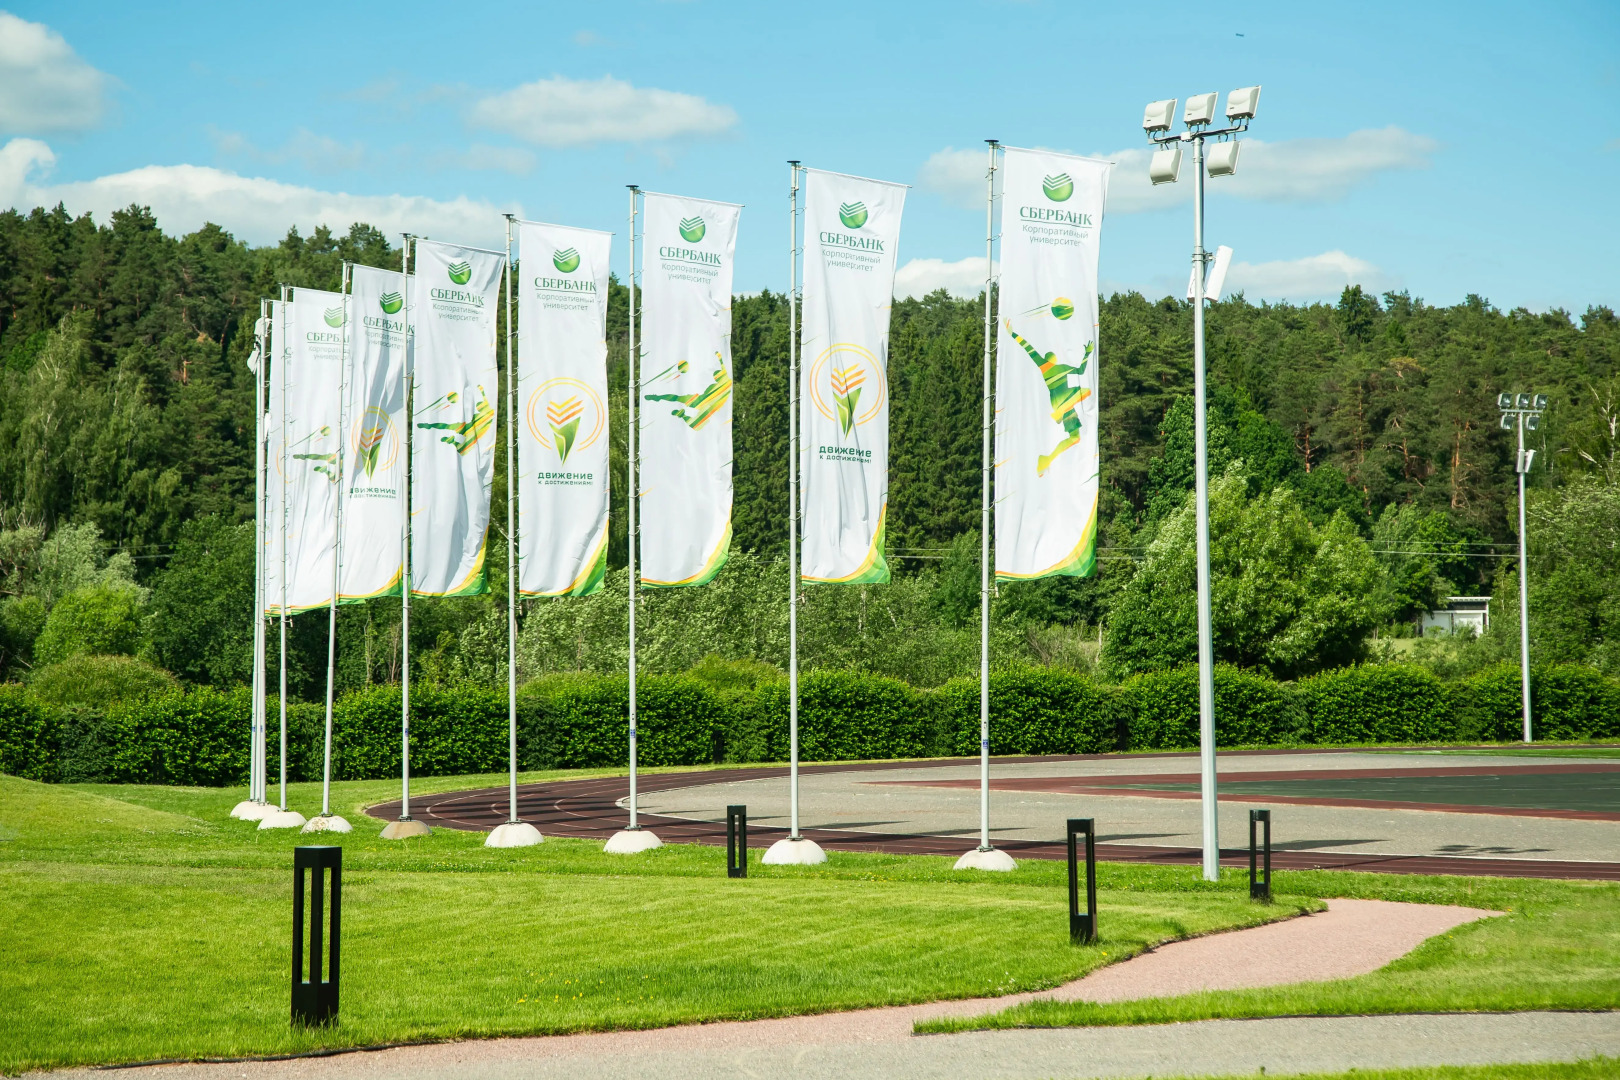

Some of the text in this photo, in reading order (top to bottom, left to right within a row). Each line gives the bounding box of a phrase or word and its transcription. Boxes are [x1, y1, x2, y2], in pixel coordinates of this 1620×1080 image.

[1019, 206, 1092, 225] СБЕРБАНК
[819, 231, 884, 251] СБЕРБАНК
[659, 246, 721, 265] СБЕРБАНК
[534, 277, 597, 292] СБЕРБАНК
[430, 287, 485, 306] СБЕРБАНК
[537, 472, 594, 480] движение
